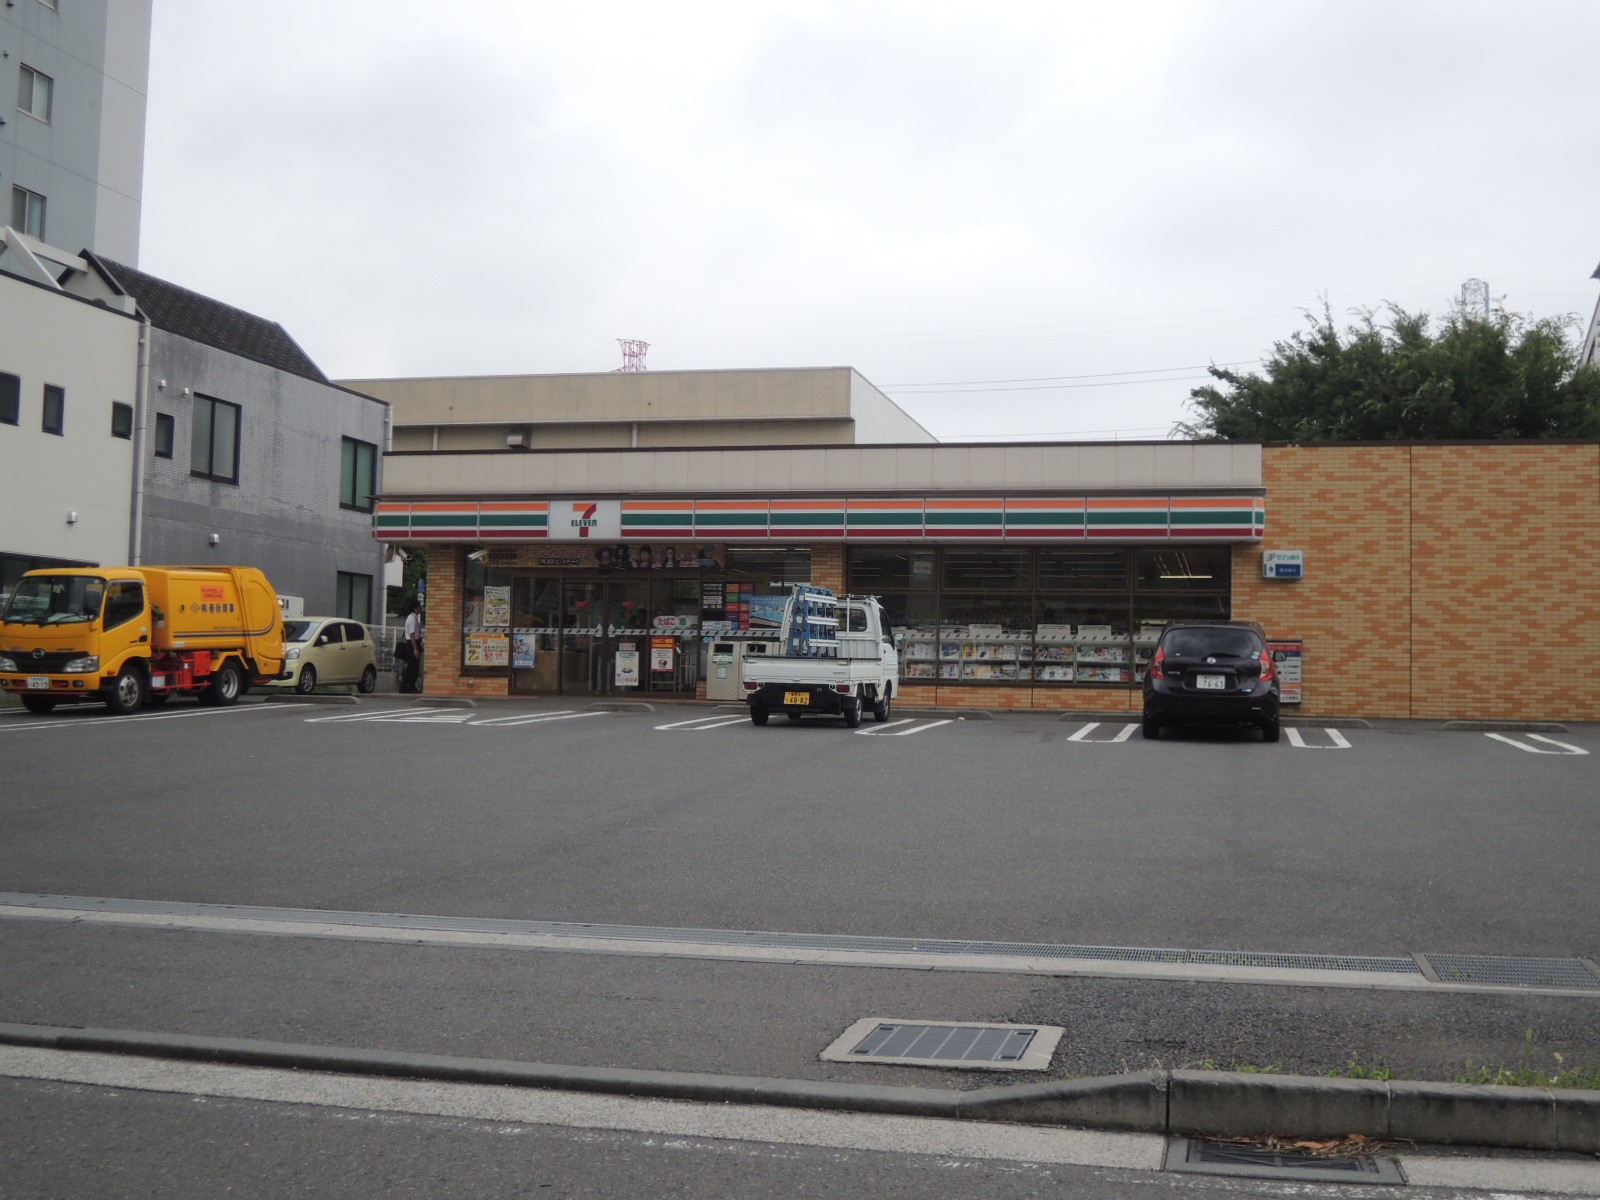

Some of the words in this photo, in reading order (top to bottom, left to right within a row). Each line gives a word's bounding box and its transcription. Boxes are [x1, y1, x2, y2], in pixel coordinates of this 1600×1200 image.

[572, 502, 597, 538] 7
[658, 617, 676, 626] たばこ
[1203, 680, 1224, 688] 76-63
[789, 697, 808, 705] 48-82
